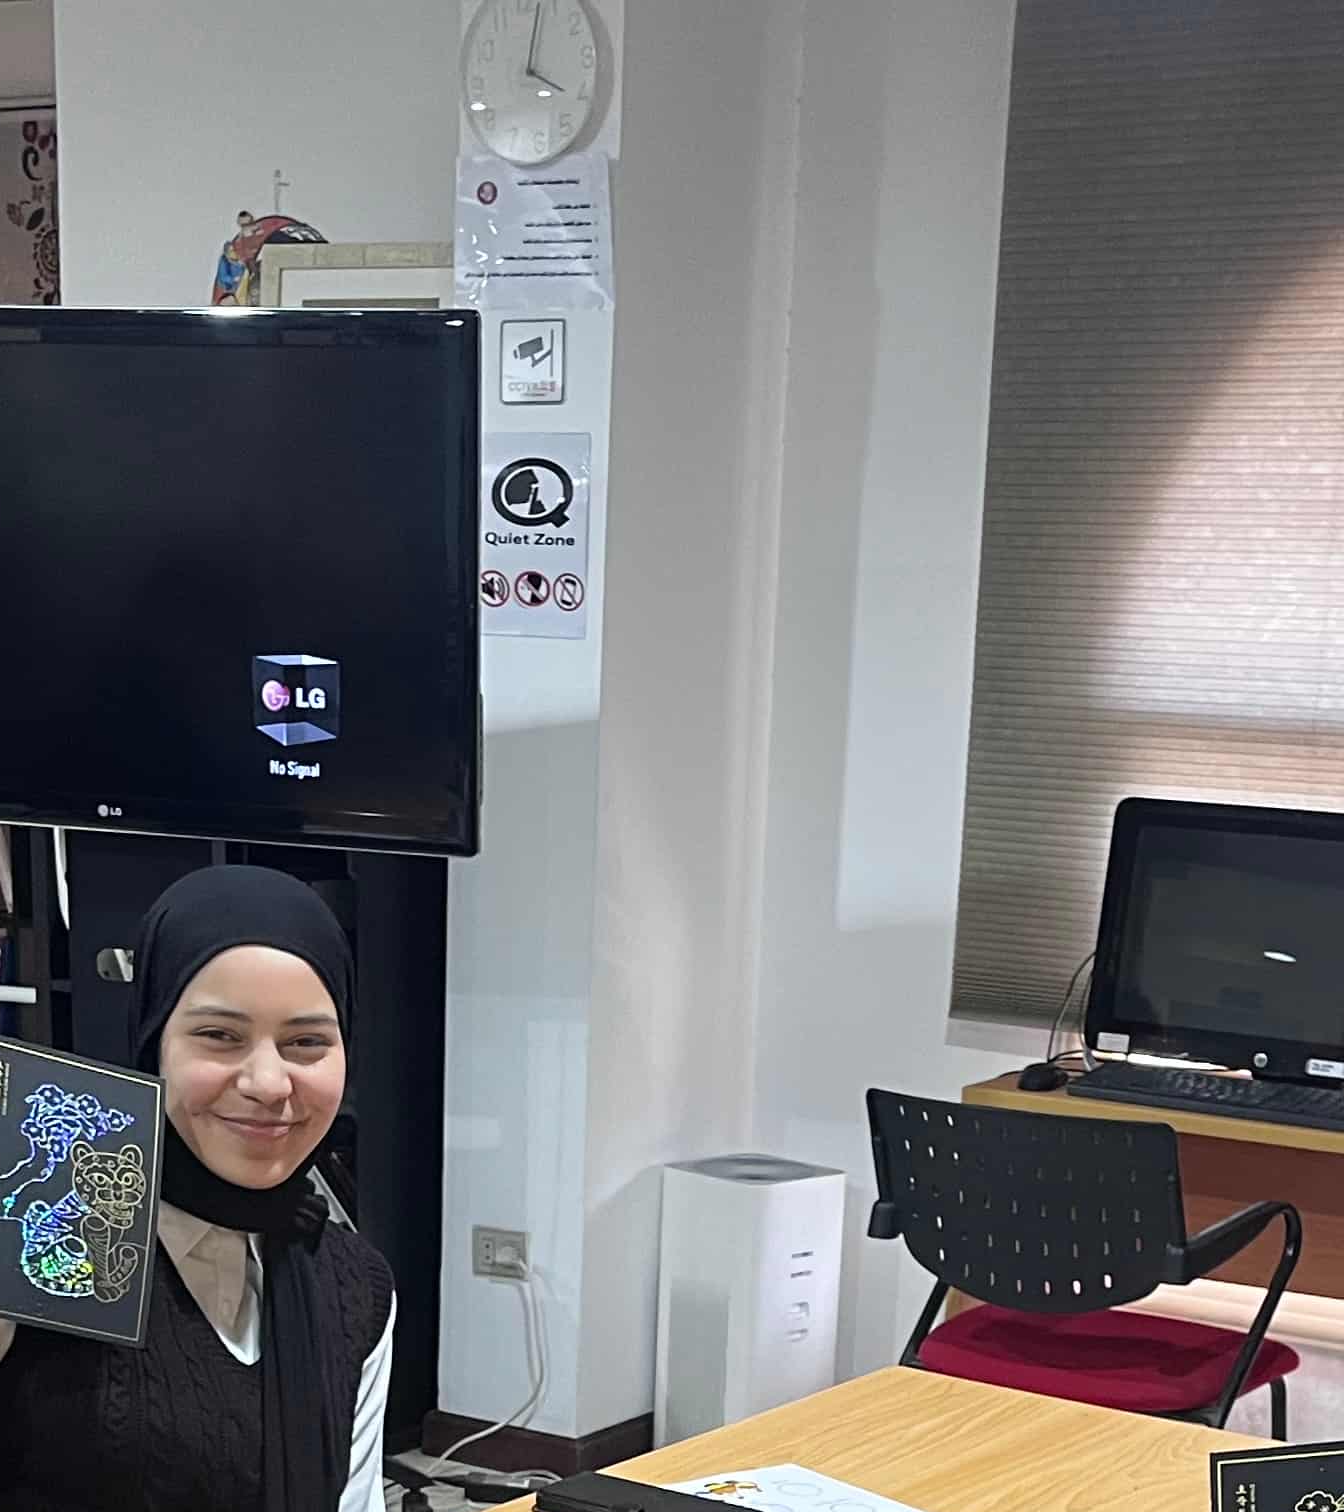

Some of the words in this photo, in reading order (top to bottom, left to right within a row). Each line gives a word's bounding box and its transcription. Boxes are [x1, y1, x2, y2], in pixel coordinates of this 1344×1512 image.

[485, 531, 530, 547] Quiet
[534, 532, 576, 546] Zone
[295, 687, 326, 709] LG
[269, 759, 286, 775] No
[287, 760, 321, 780] Signal
